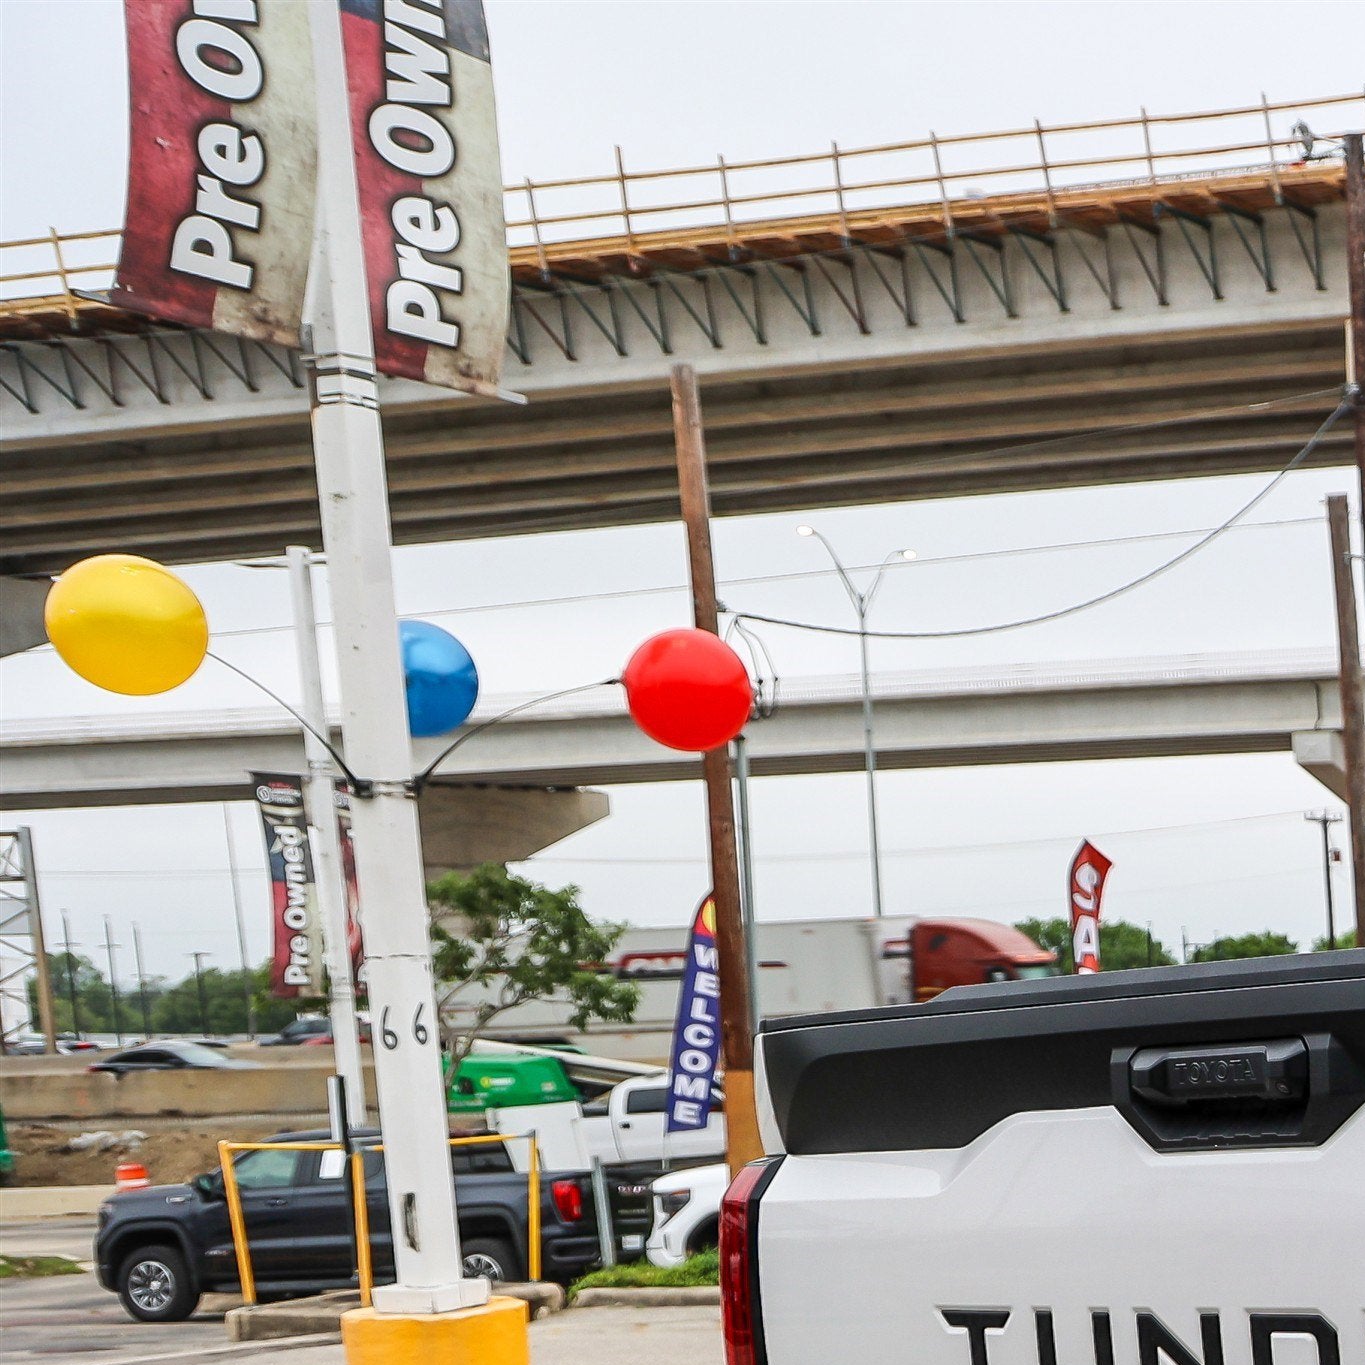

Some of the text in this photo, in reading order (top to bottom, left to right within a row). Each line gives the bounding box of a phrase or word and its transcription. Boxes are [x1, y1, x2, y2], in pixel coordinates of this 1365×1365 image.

[170, 0, 265, 290] Pre O
[386, 197, 461, 347] Pre
[273, 825, 307, 931] Owned
[284, 934, 312, 986] Pre
[672, 943, 721, 1126] WELCOME
[1174, 1058, 1257, 1085] TOYOTA
